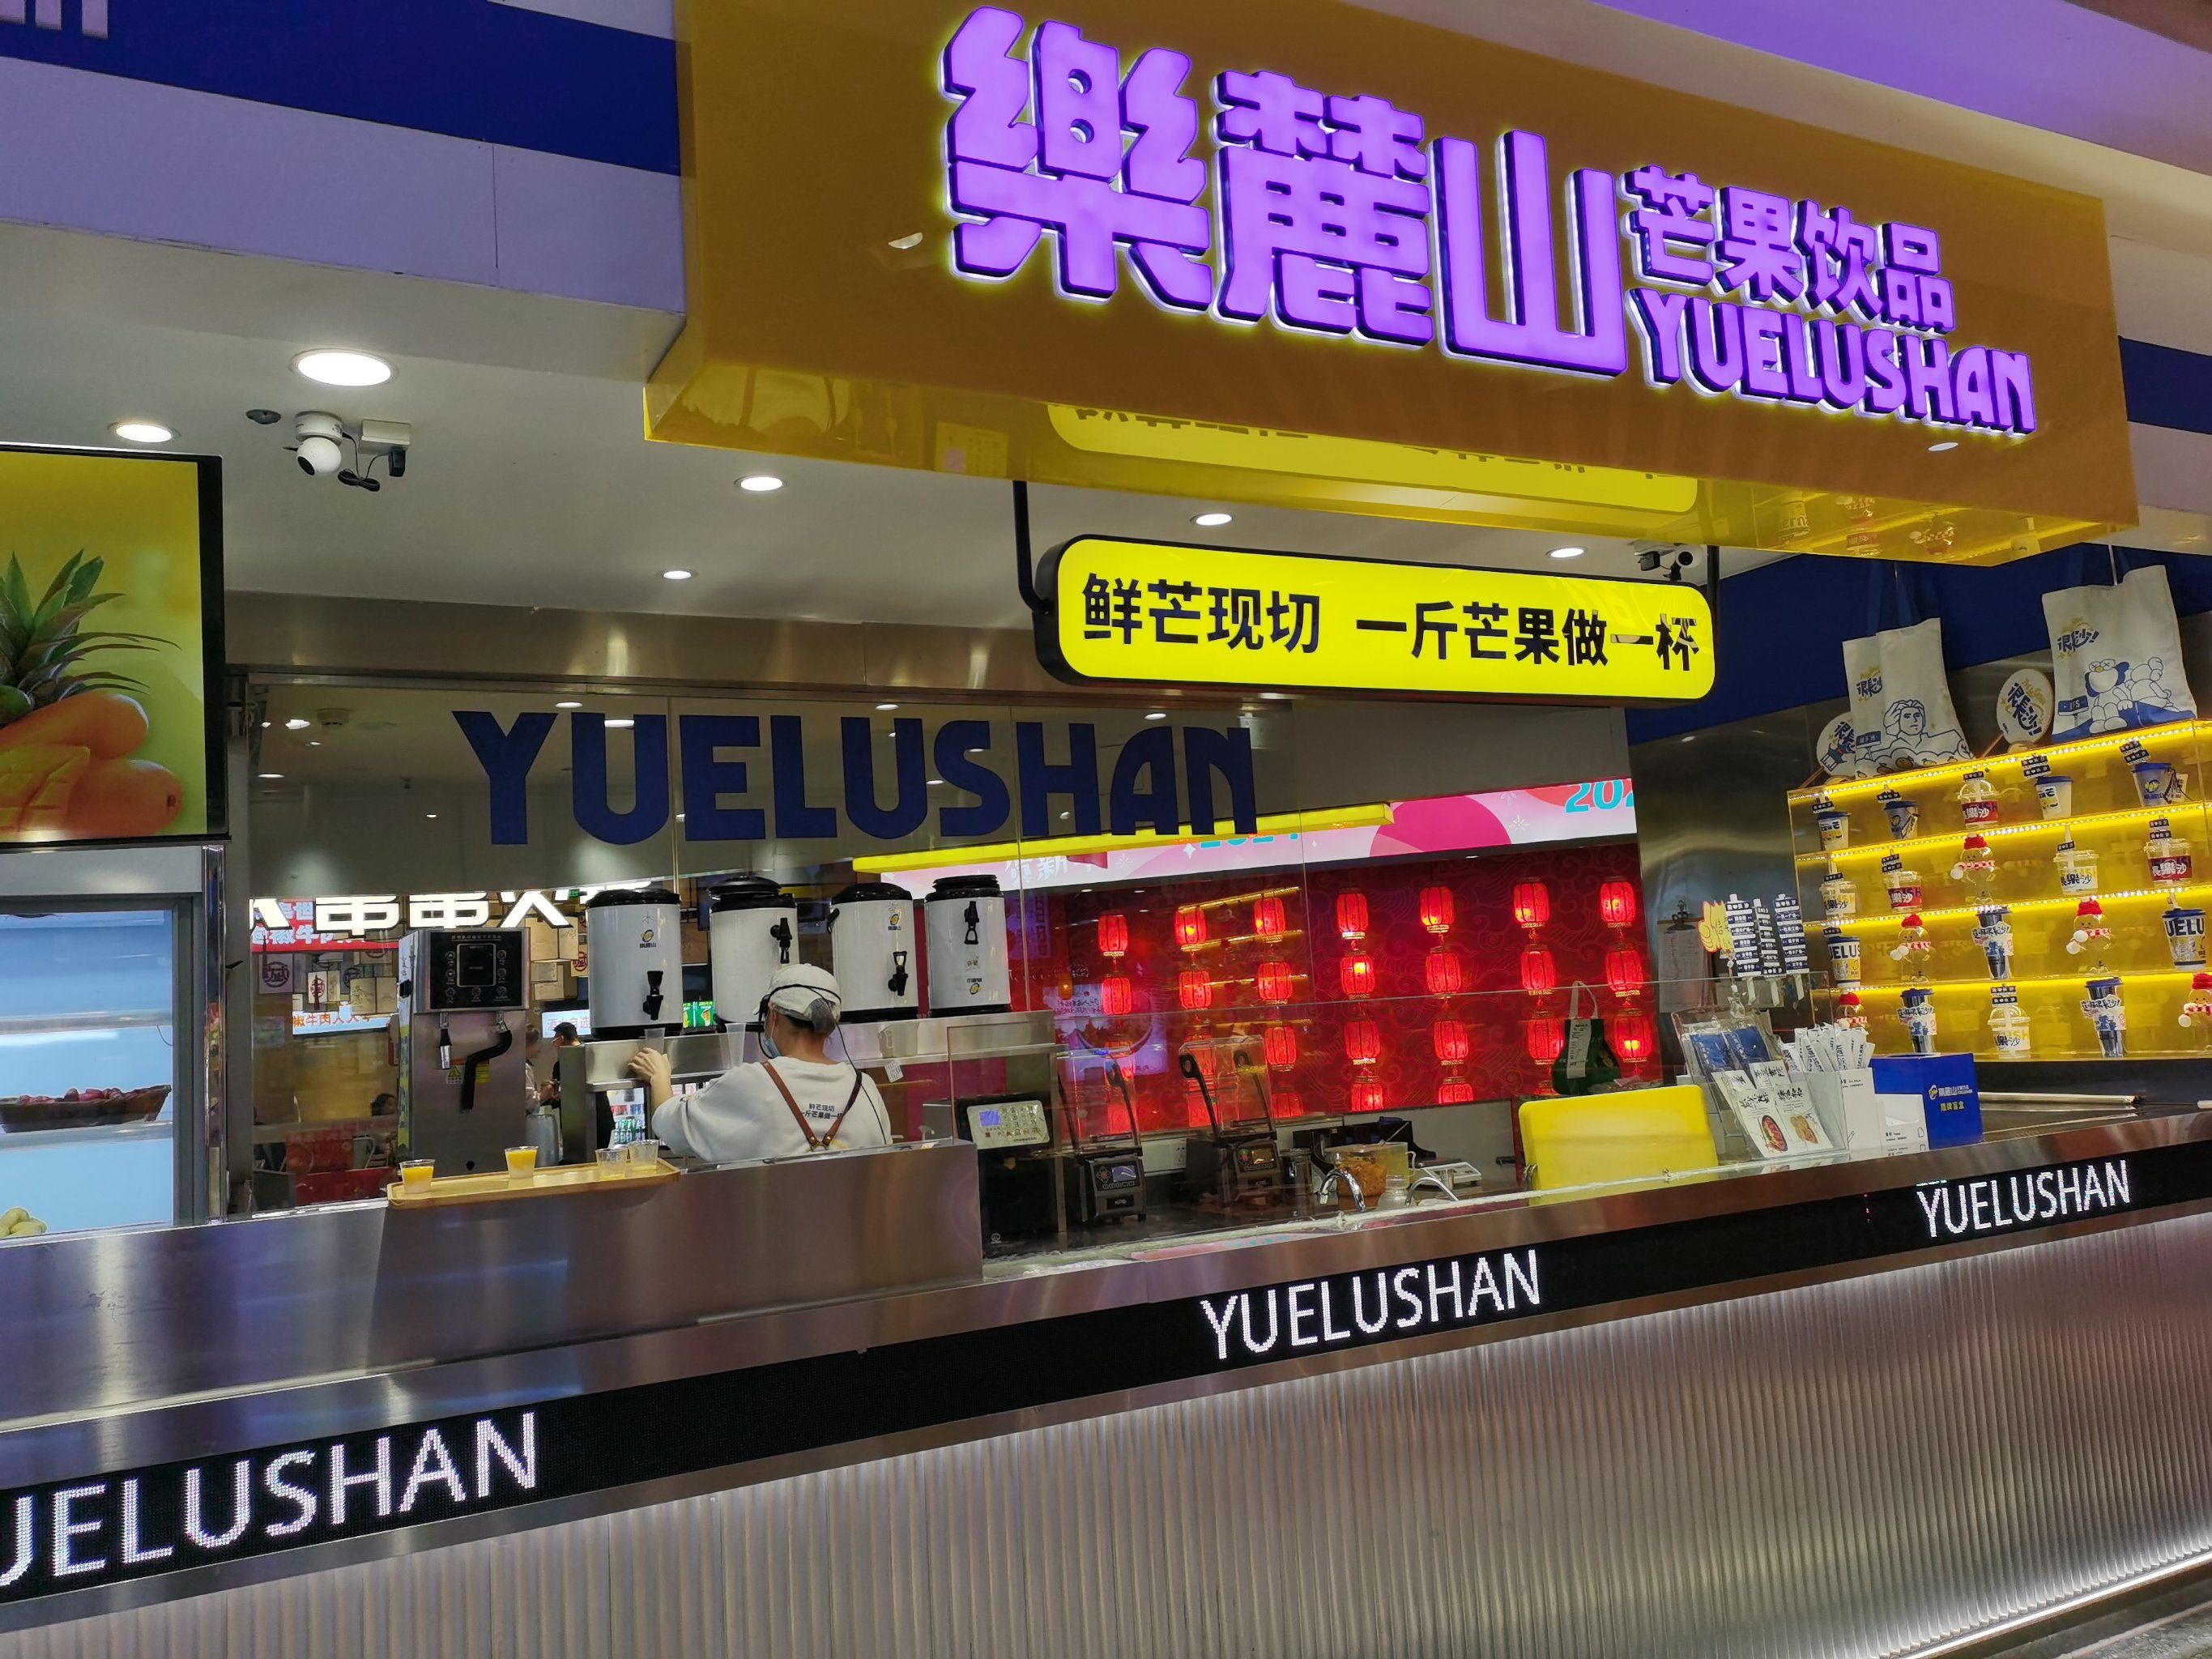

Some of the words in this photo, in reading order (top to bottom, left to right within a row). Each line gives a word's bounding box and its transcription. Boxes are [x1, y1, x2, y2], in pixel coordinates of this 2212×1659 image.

[942, 6, 1626, 376] 樂麓山
[1624, 165, 1956, 335] 芒果饮品
[1629, 288, 2038, 435] YUELUSHAN
[1082, 573, 1320, 654] 鲜芒现切
[1356, 601, 1700, 672] 一斤芒果做一杯
[452, 711, 1259, 845] YUELUSHAN
[1916, 1159, 2131, 1238] YUELUSHAN
[1200, 1249, 1541, 1359] YUELUSHAN
